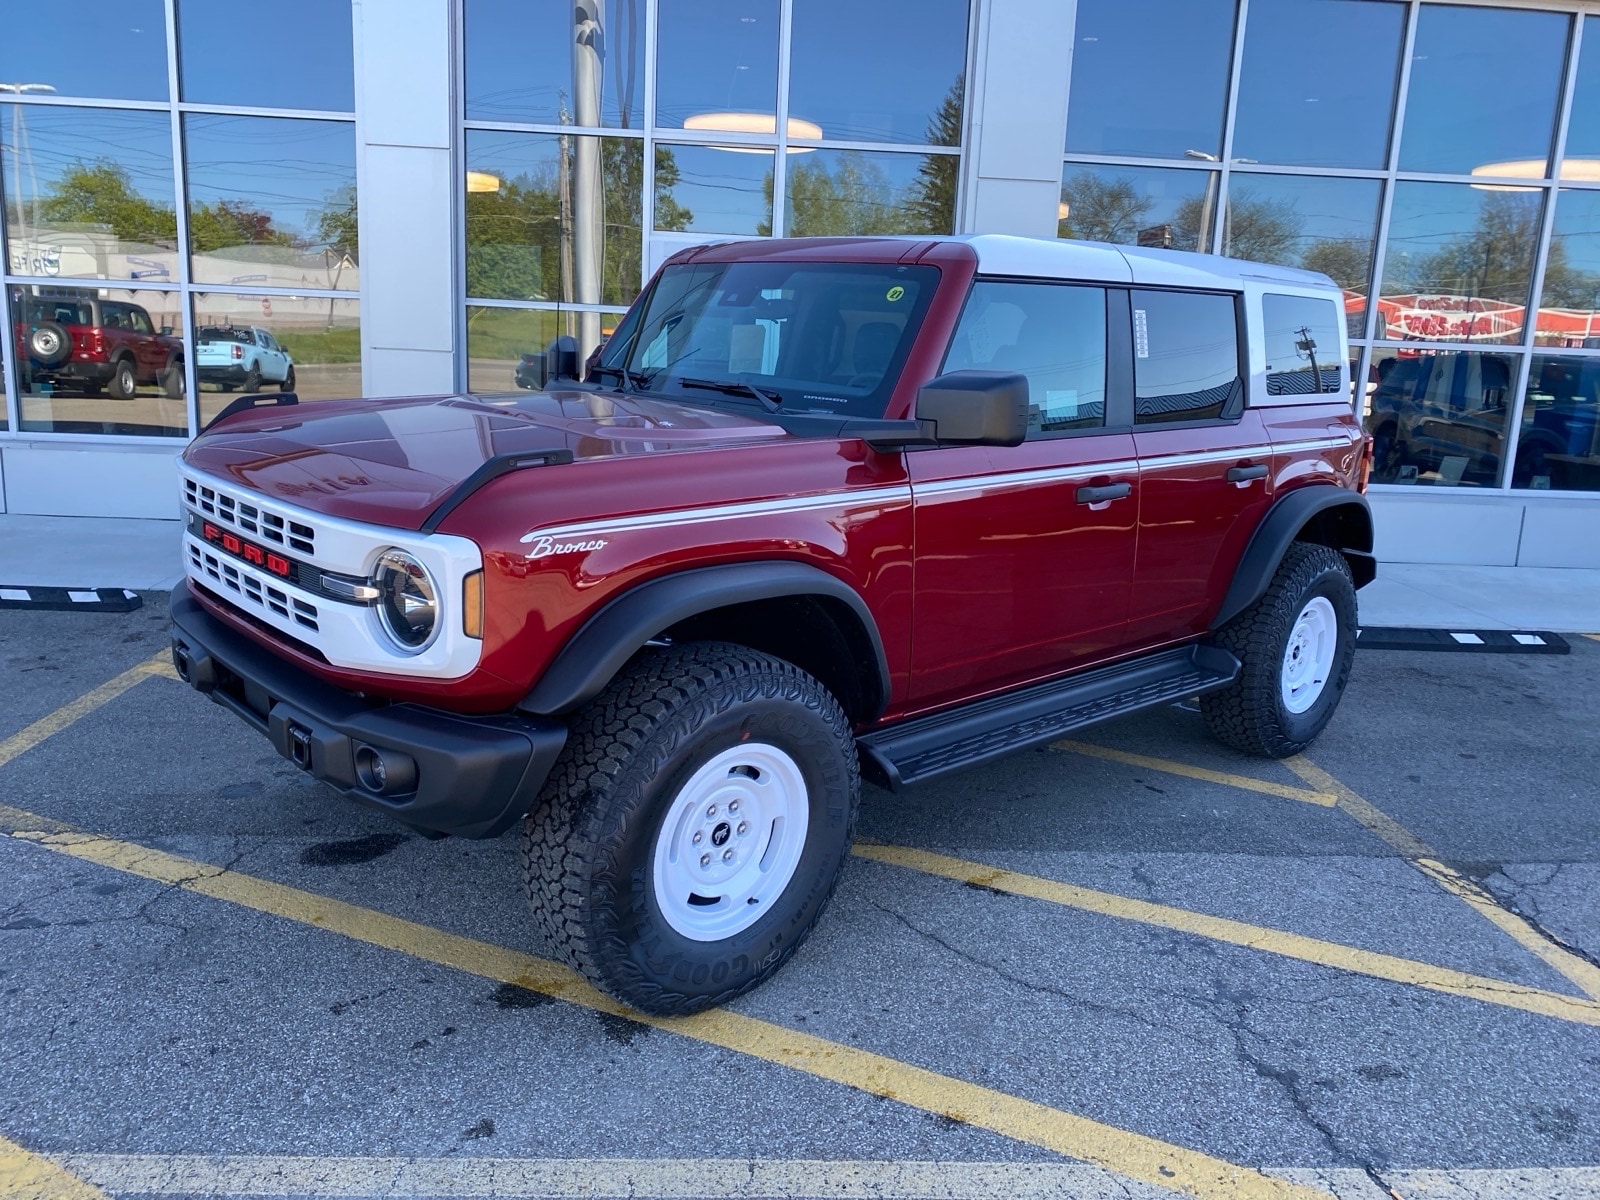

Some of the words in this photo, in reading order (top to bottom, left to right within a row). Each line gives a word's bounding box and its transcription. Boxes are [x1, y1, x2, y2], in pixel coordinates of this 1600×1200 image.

[889, 289, 903, 299] 27
[203, 522, 290, 576] FORD
[524, 536, 608, 559] Bronco
[631, 866, 749, 985] GOODYEAR
